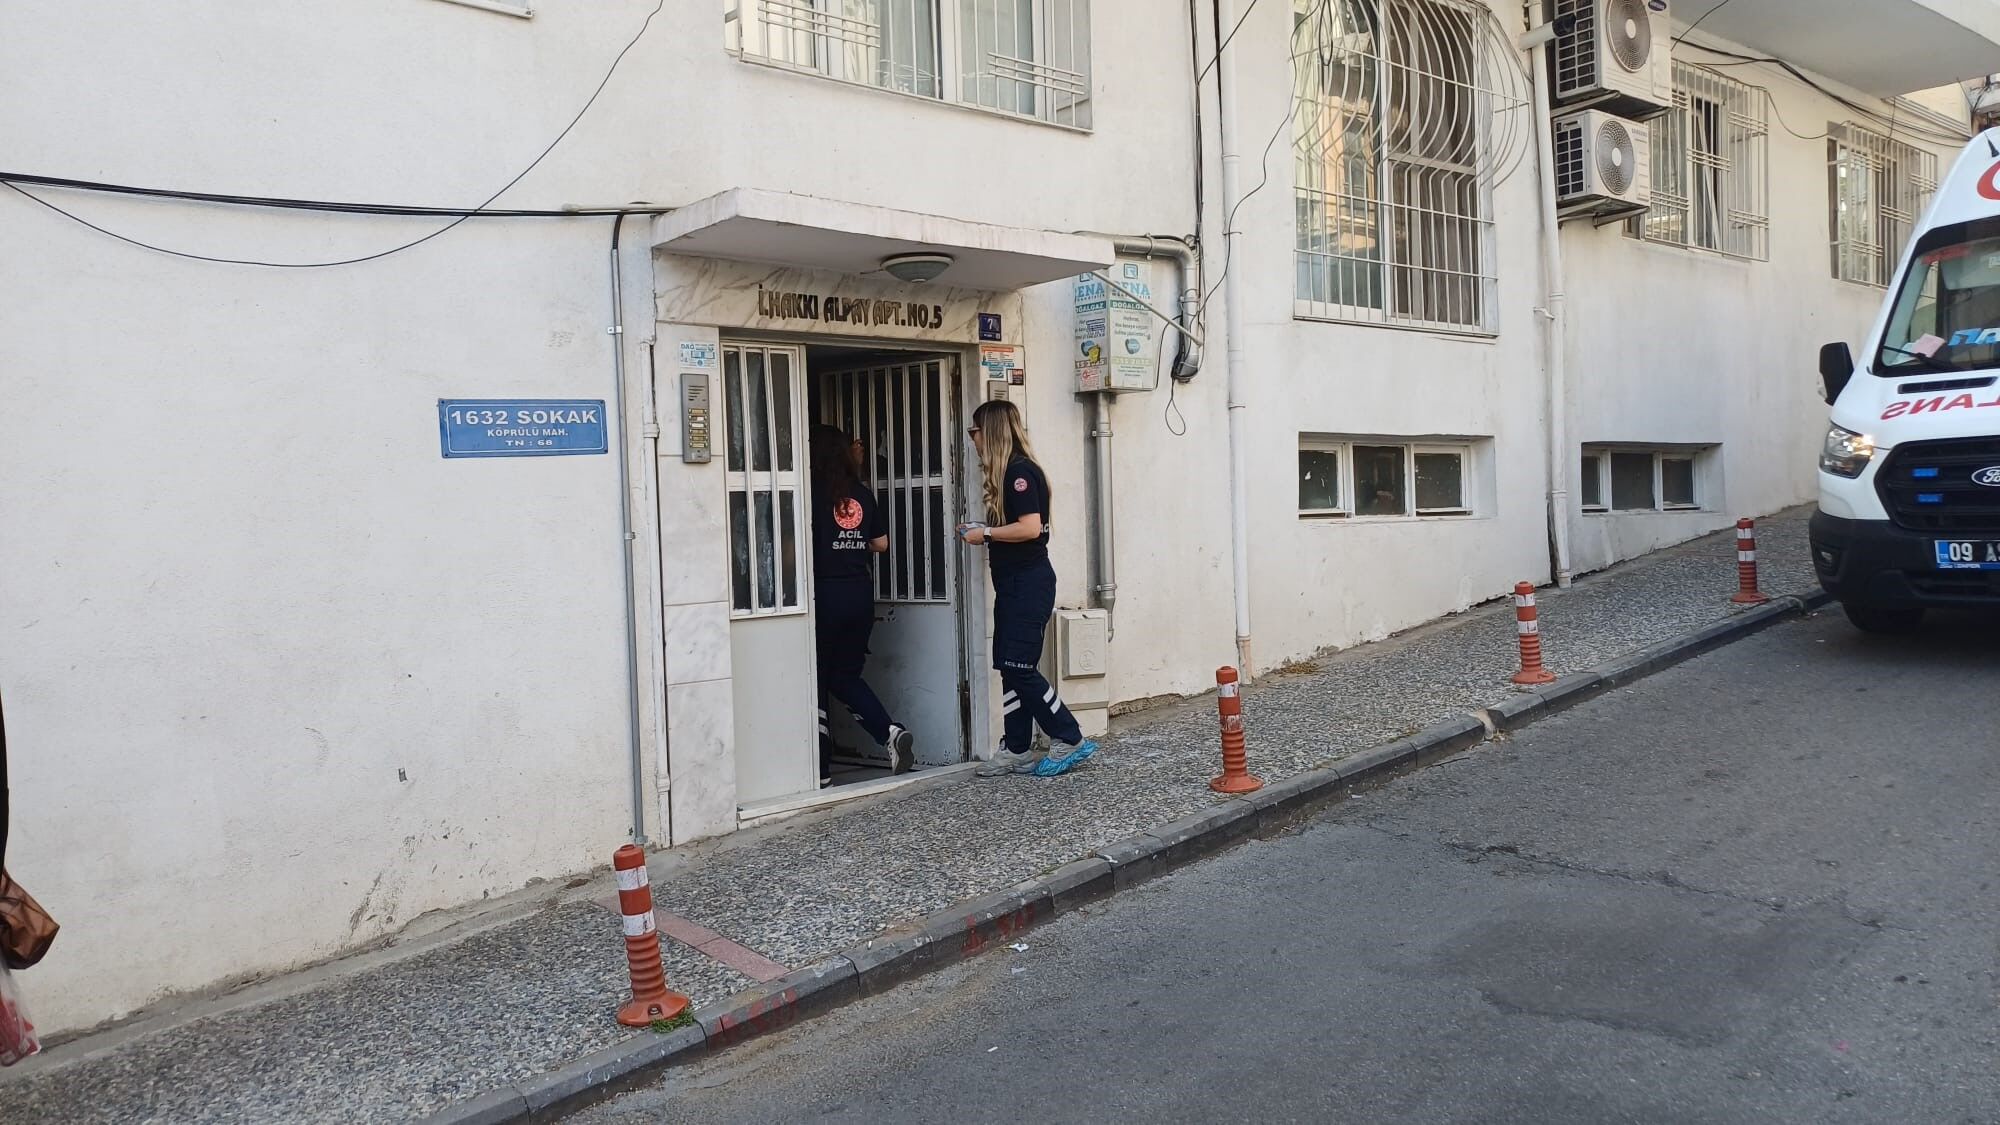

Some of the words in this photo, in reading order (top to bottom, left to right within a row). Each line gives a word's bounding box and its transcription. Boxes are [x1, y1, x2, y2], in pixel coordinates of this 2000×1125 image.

[1075, 282, 1105, 298] ENA
[823, 296, 870, 327] ALPAY
[451, 410, 509, 425] 1632
[517, 410, 598, 425] SOKAK
[487, 426, 539, 437] KÖPRÜLÜ
[542, 427, 569, 437] MAH.
[832, 540, 866, 550] SAĞLIK
[1949, 542, 1973, 562] 09
